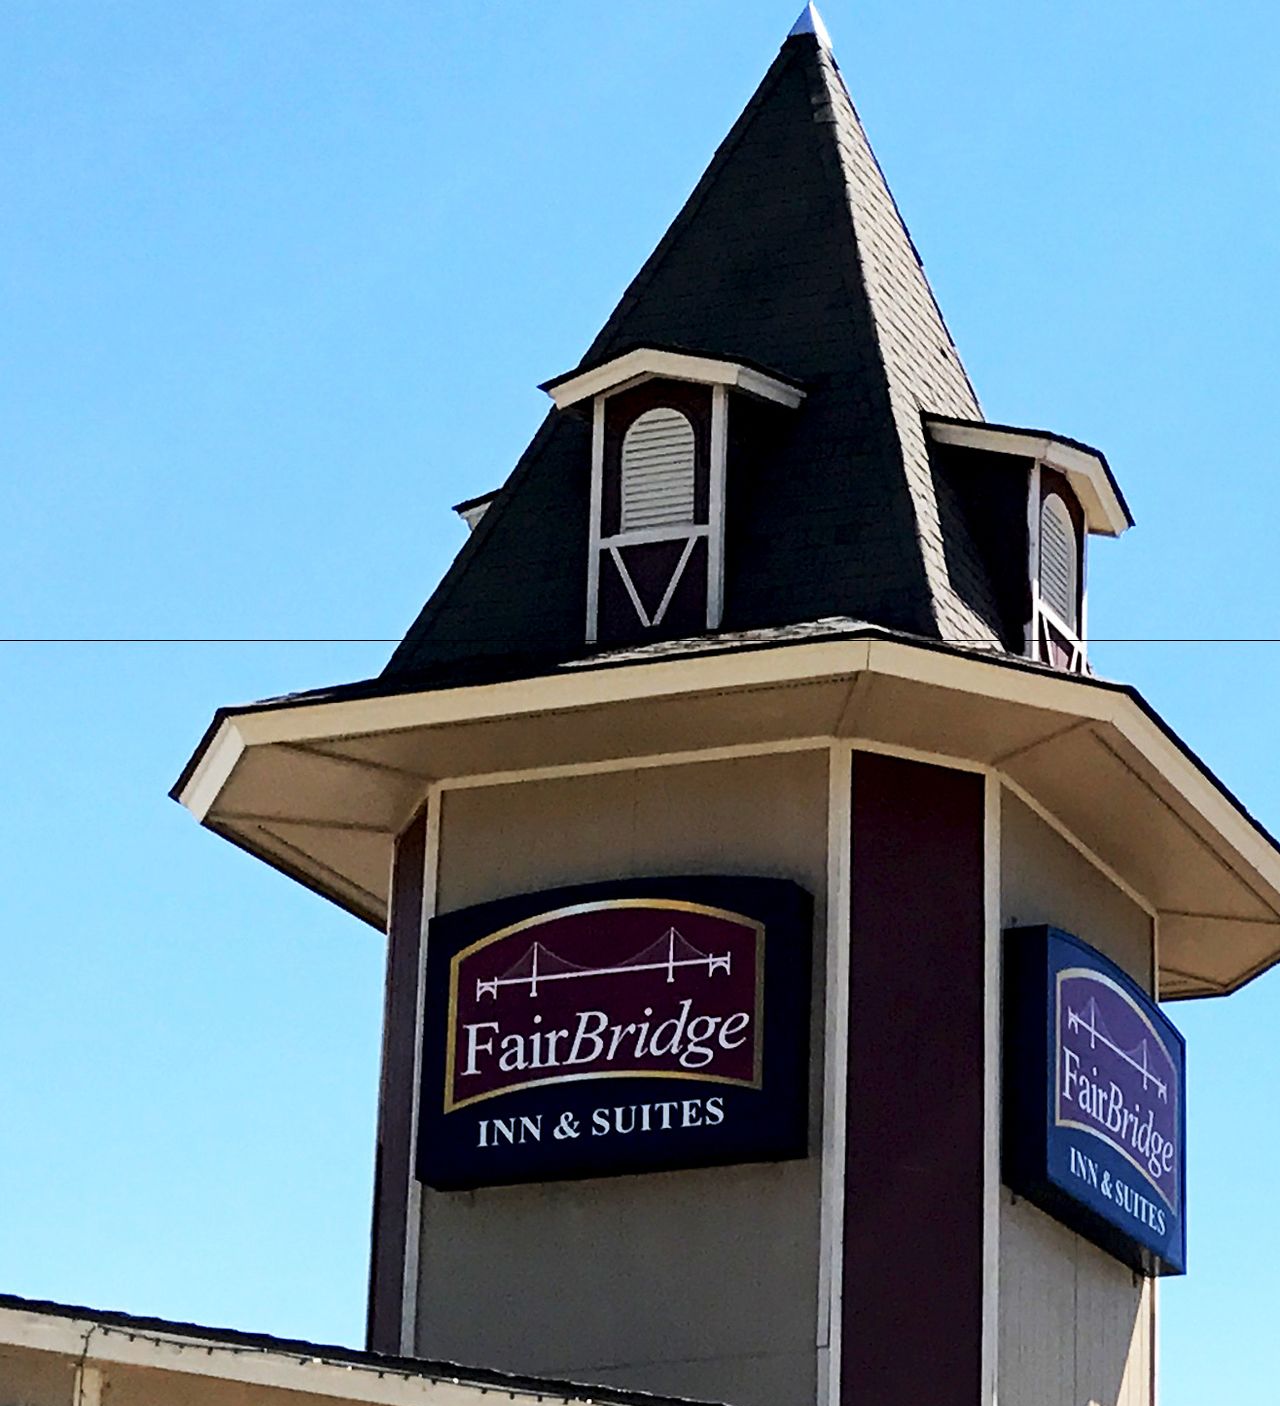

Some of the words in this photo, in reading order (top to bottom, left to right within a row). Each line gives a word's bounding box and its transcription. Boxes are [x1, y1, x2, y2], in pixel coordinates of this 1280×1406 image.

[460, 999, 749, 1076] FairBridge
[476, 1114, 543, 1148] INN
[552, 1111, 581, 1140] &
[591, 1097, 725, 1136] SUITES
[1062, 1046, 1173, 1178] FairBridge
[1069, 1146, 1099, 1189] INN
[1101, 1169, 1113, 1200] &
[1115, 1179, 1166, 1236] SUITES
